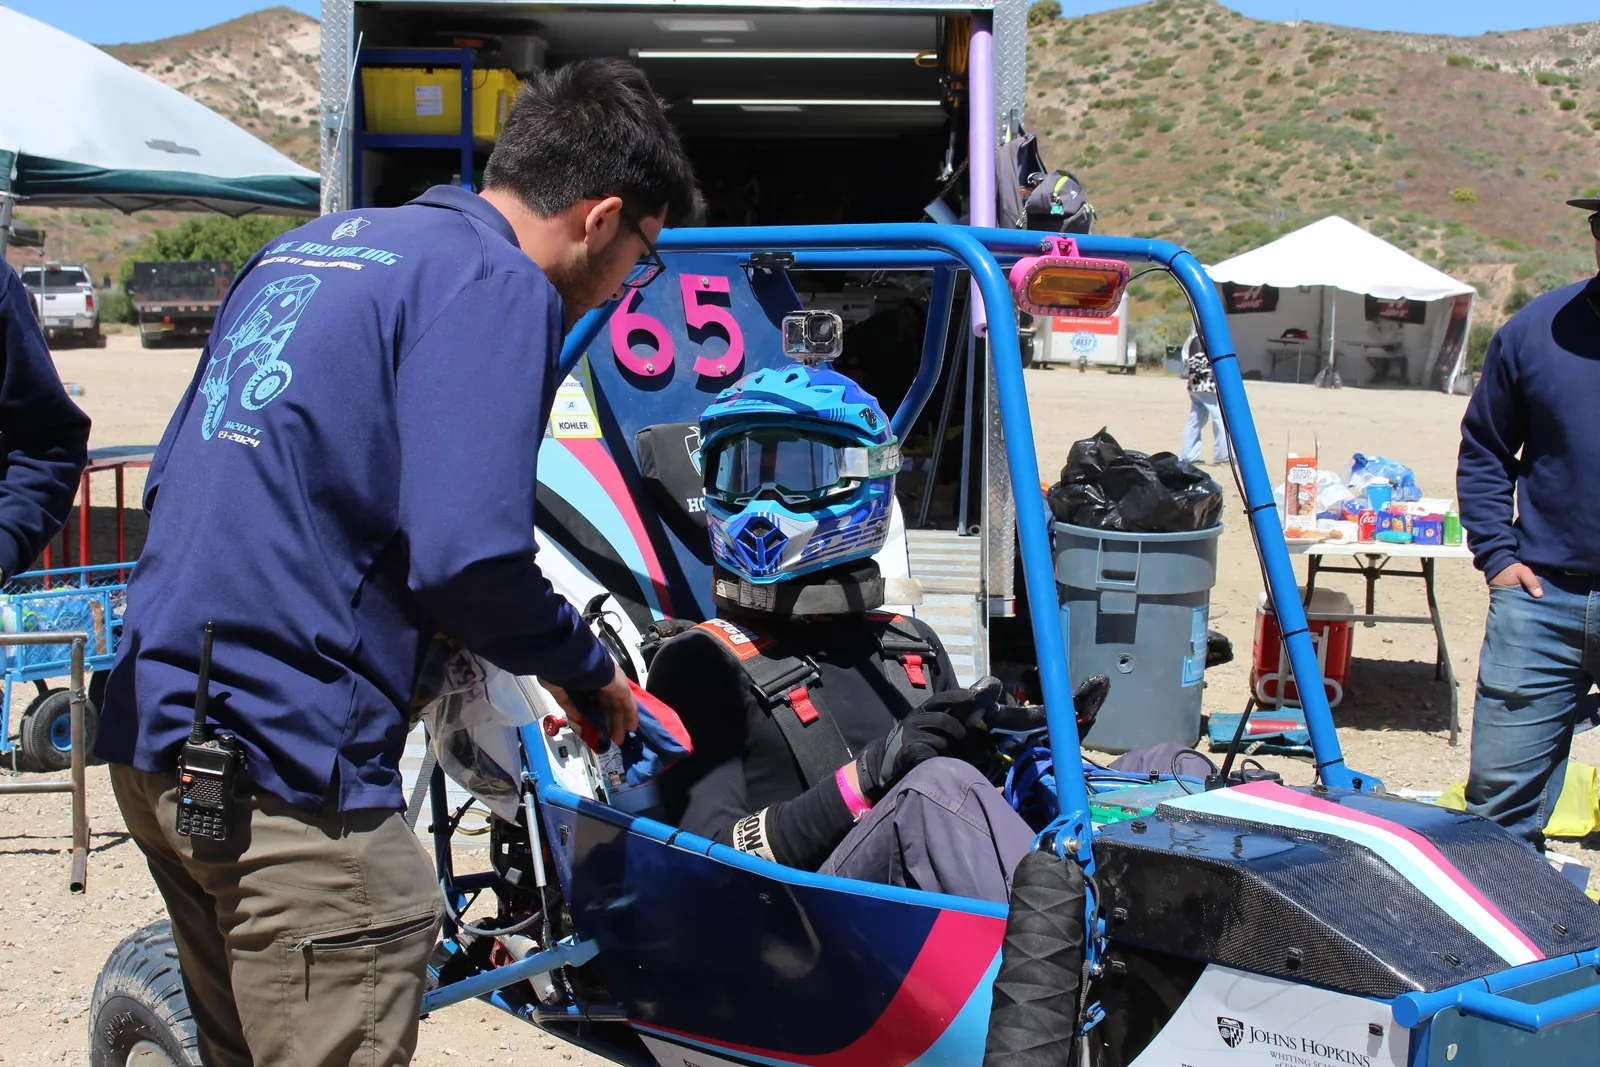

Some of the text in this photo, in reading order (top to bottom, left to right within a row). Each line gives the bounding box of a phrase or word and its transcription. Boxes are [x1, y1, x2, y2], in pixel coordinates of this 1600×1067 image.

[291, 242, 334, 256] JAY
[326, 246, 403, 265] RACING
[609, 273, 745, 378] 65
[1075, 338, 1092, 347] BEST
[558, 421, 589, 430] KOHLER
[1249, 1026, 1371, 1067] JOHNS HOPKINS
[1269, 1050, 1311, 1066] WHITING
